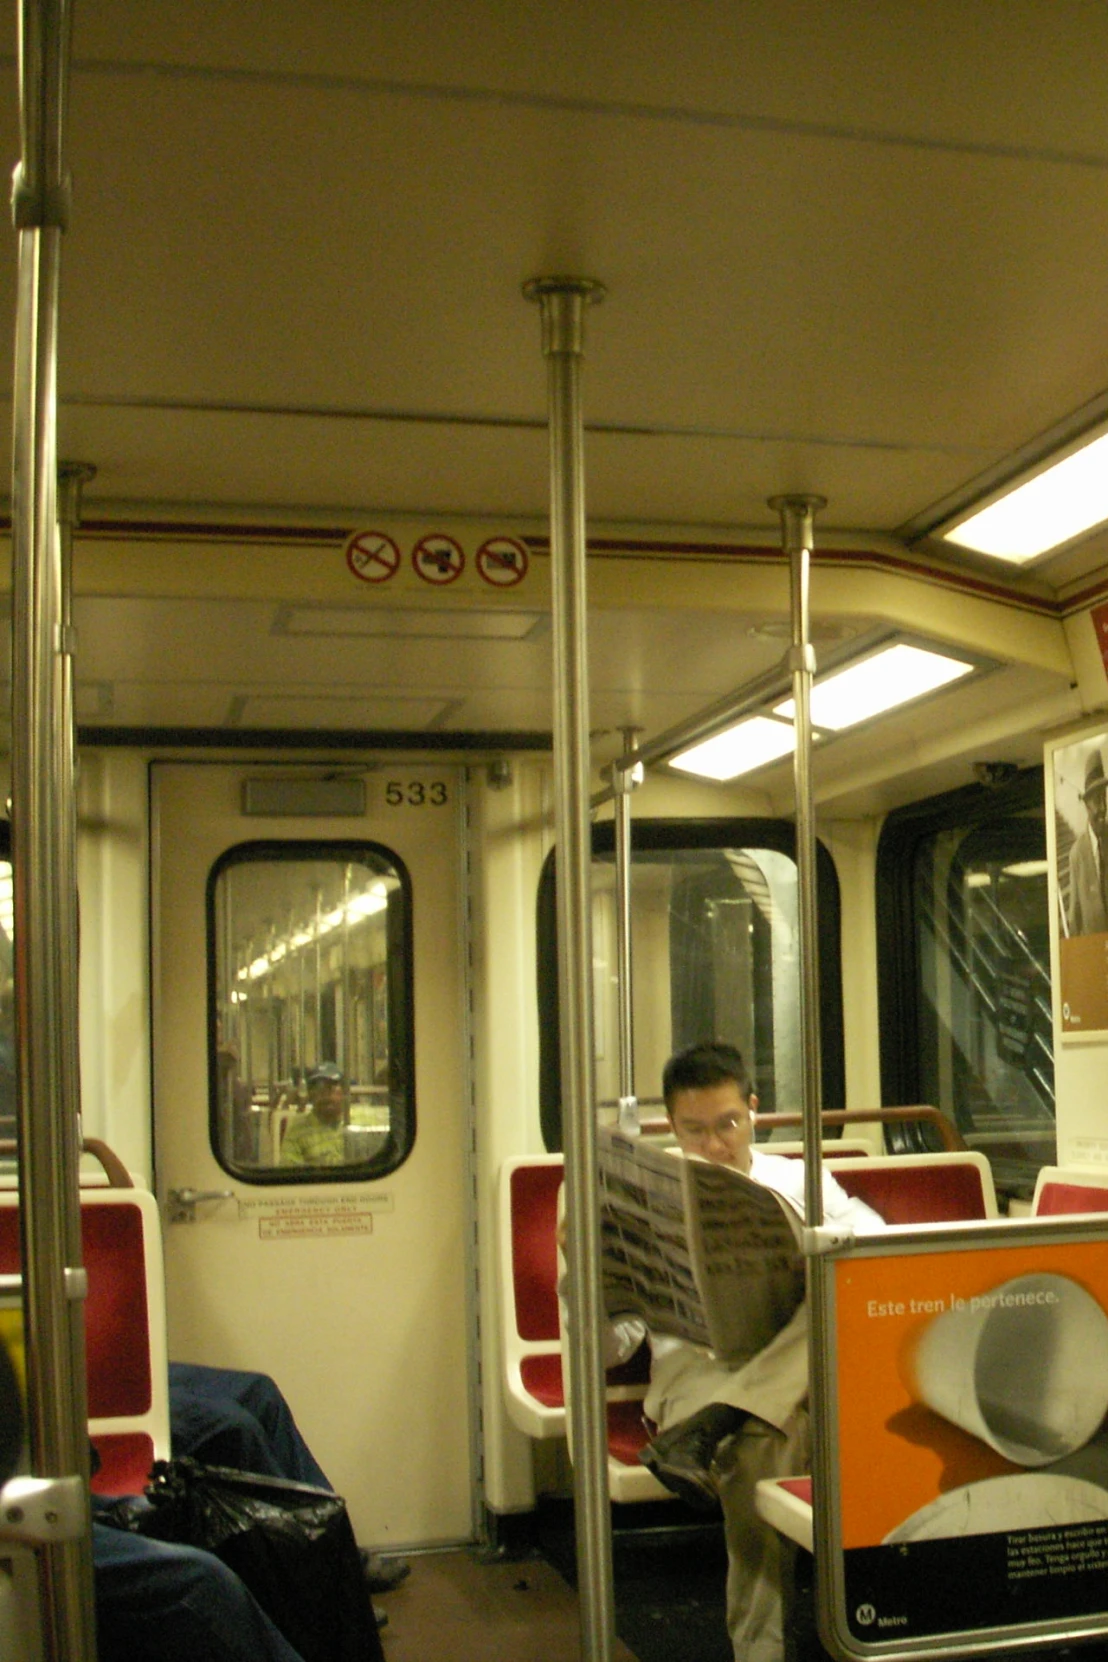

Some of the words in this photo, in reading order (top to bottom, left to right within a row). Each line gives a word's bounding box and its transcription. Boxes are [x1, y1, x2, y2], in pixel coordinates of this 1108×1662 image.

[386, 781, 448, 806] 533
[867, 1299, 906, 1317] Este
[910, 1298, 945, 1315] tren
[950, 1293, 965, 1311] le
[970, 1290, 1060, 1313] pertenece.
[878, 1616, 908, 1628] Metro
